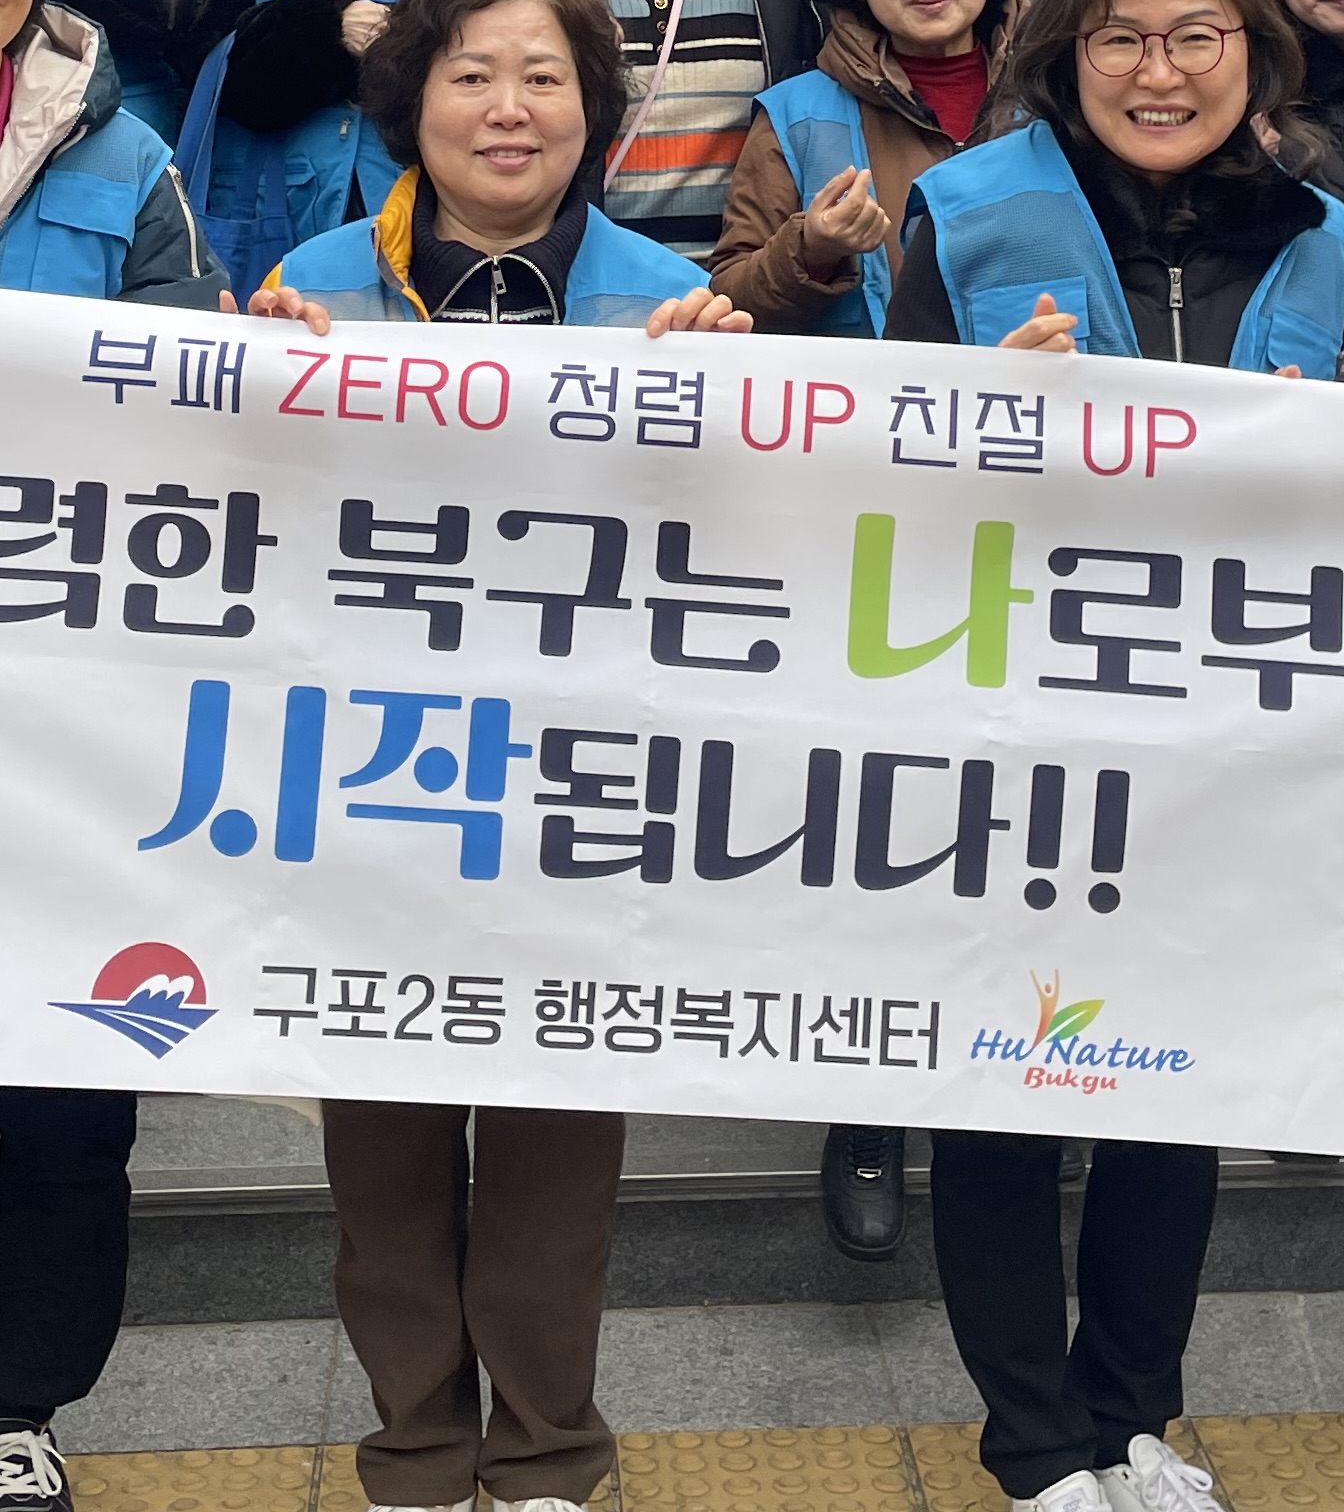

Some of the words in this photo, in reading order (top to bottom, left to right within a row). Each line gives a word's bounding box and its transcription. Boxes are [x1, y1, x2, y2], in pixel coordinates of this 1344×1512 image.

[81, 328, 246, 414] 부패
[278, 348, 511, 431] ZERO
[547, 366, 706, 449] 청렴
[740, 377, 856, 453] UP
[889, 385, 1046, 474] 친절
[1082, 401, 1198, 478] UP
[326, 497, 792, 675] 북구는
[138, 678, 1132, 915] 시작됩니다!!
[253, 965, 507, 1046] 구포2동
[534, 978, 941, 1071] 행정복지센터
[970, 1028, 1034, 1062] Hu
[1044, 1035, 1196, 1072] Nature
[1023, 1066, 1118, 1095] Bukgu
